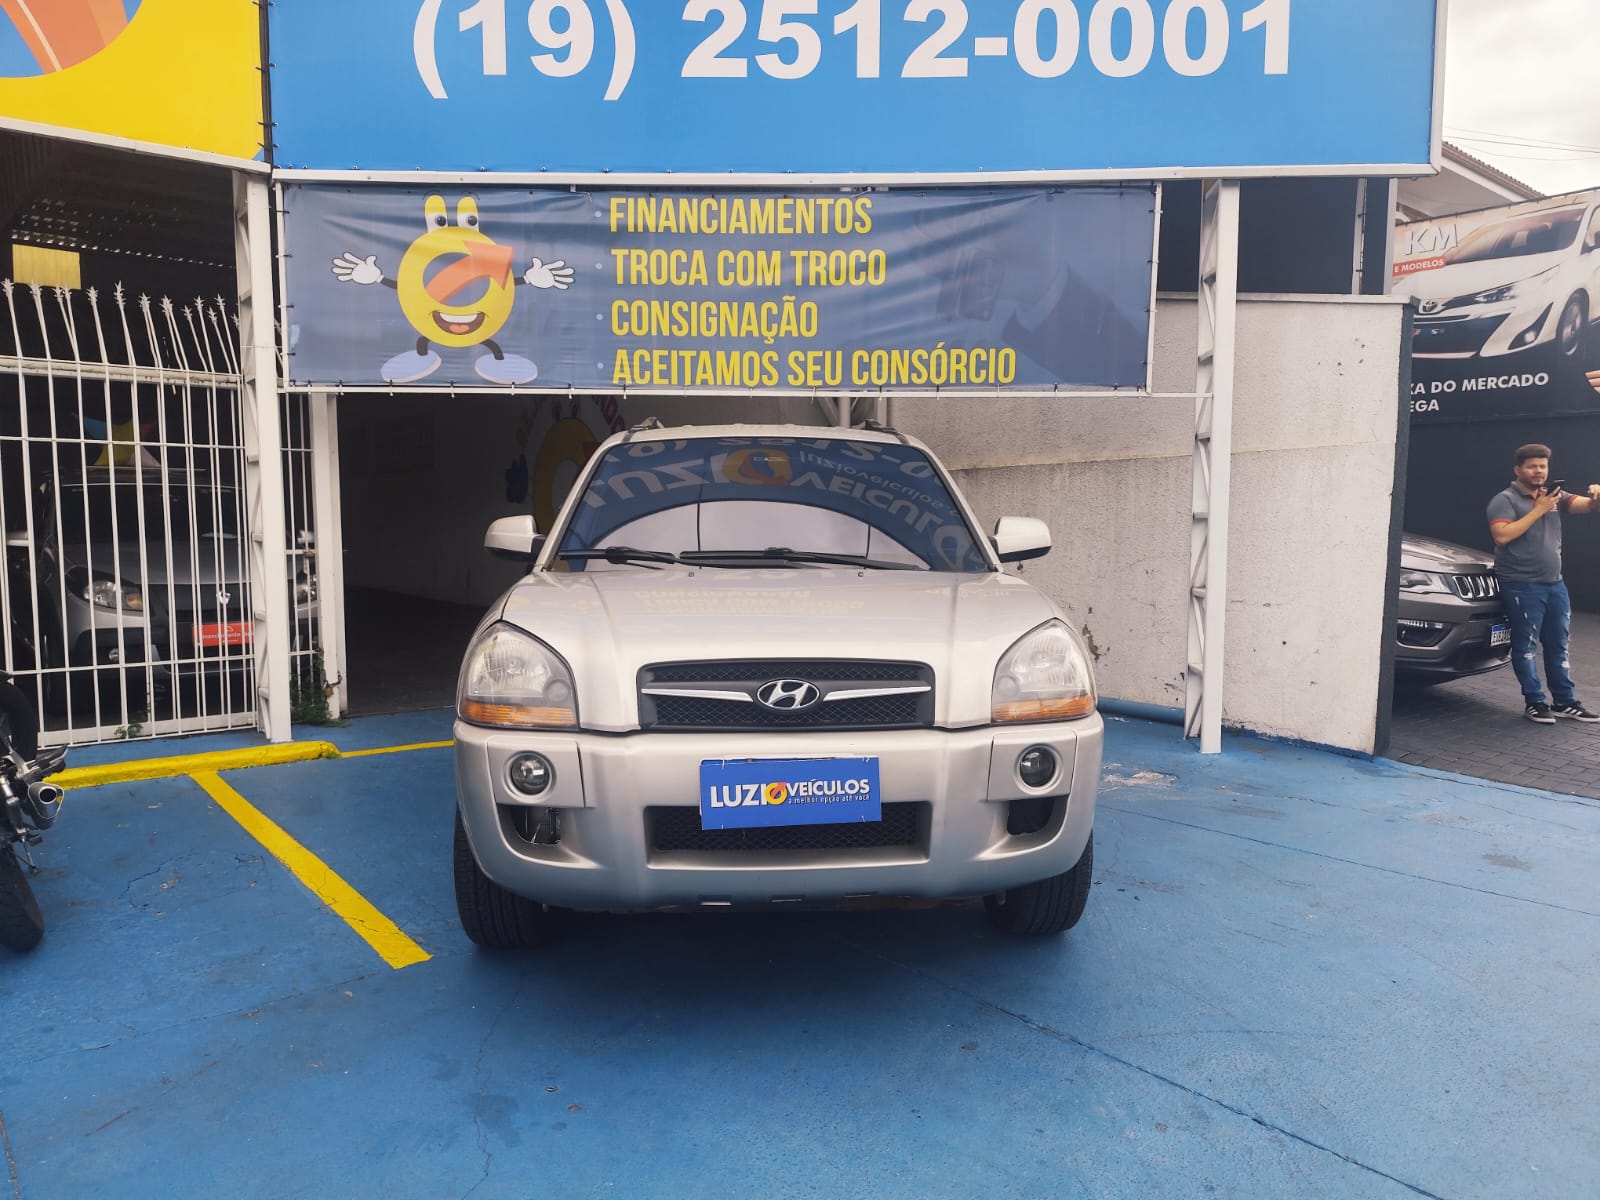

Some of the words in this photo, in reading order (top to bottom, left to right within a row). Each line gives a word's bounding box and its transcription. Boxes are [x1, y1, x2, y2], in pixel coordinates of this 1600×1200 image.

[413, 0, 636, 101] (19)
[681, 0, 1291, 80] 2512-0001
[609, 196, 873, 236] FINANCIAMENTOS
[612, 248, 709, 286] TROCA
[717, 250, 781, 286] COM
[791, 249, 888, 286] TROCO
[1401, 259, 1444, 272] MODELOS
[611, 295, 818, 345] CONSIGNAÇÃO
[612, 350, 779, 387] ACEITAMOS
[787, 351, 843, 387] SEU
[851, 341, 1017, 385] CONSÓRCIO
[1430, 380, 1457, 394] DO
[1461, 372, 1550, 392] MERCADO
[786, 779, 870, 797] VEÍCULOS
